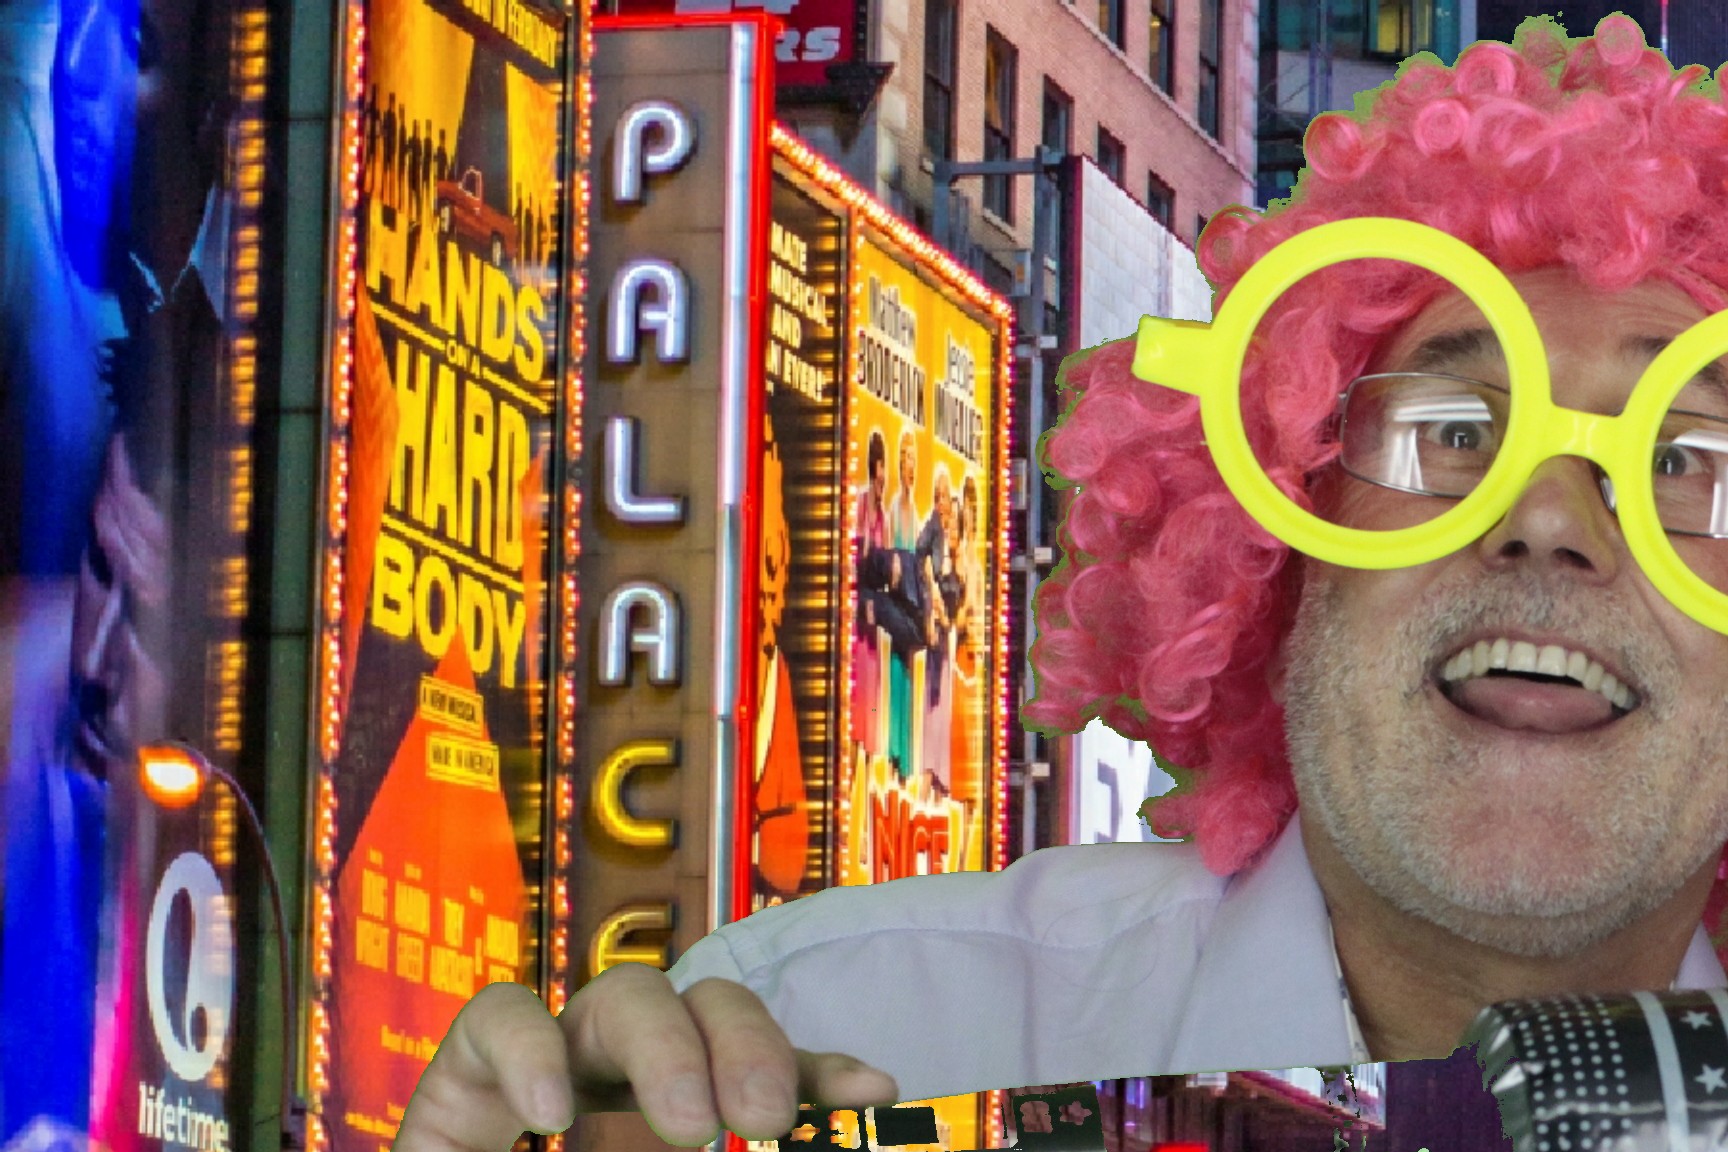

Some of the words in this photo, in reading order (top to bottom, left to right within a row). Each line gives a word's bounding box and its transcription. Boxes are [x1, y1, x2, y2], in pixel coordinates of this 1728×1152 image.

[366, 197, 546, 383] HANDS
[390, 338, 527, 572] HARD
[588, 100, 693, 973] PALACE
[371, 535, 526, 690] BODY
